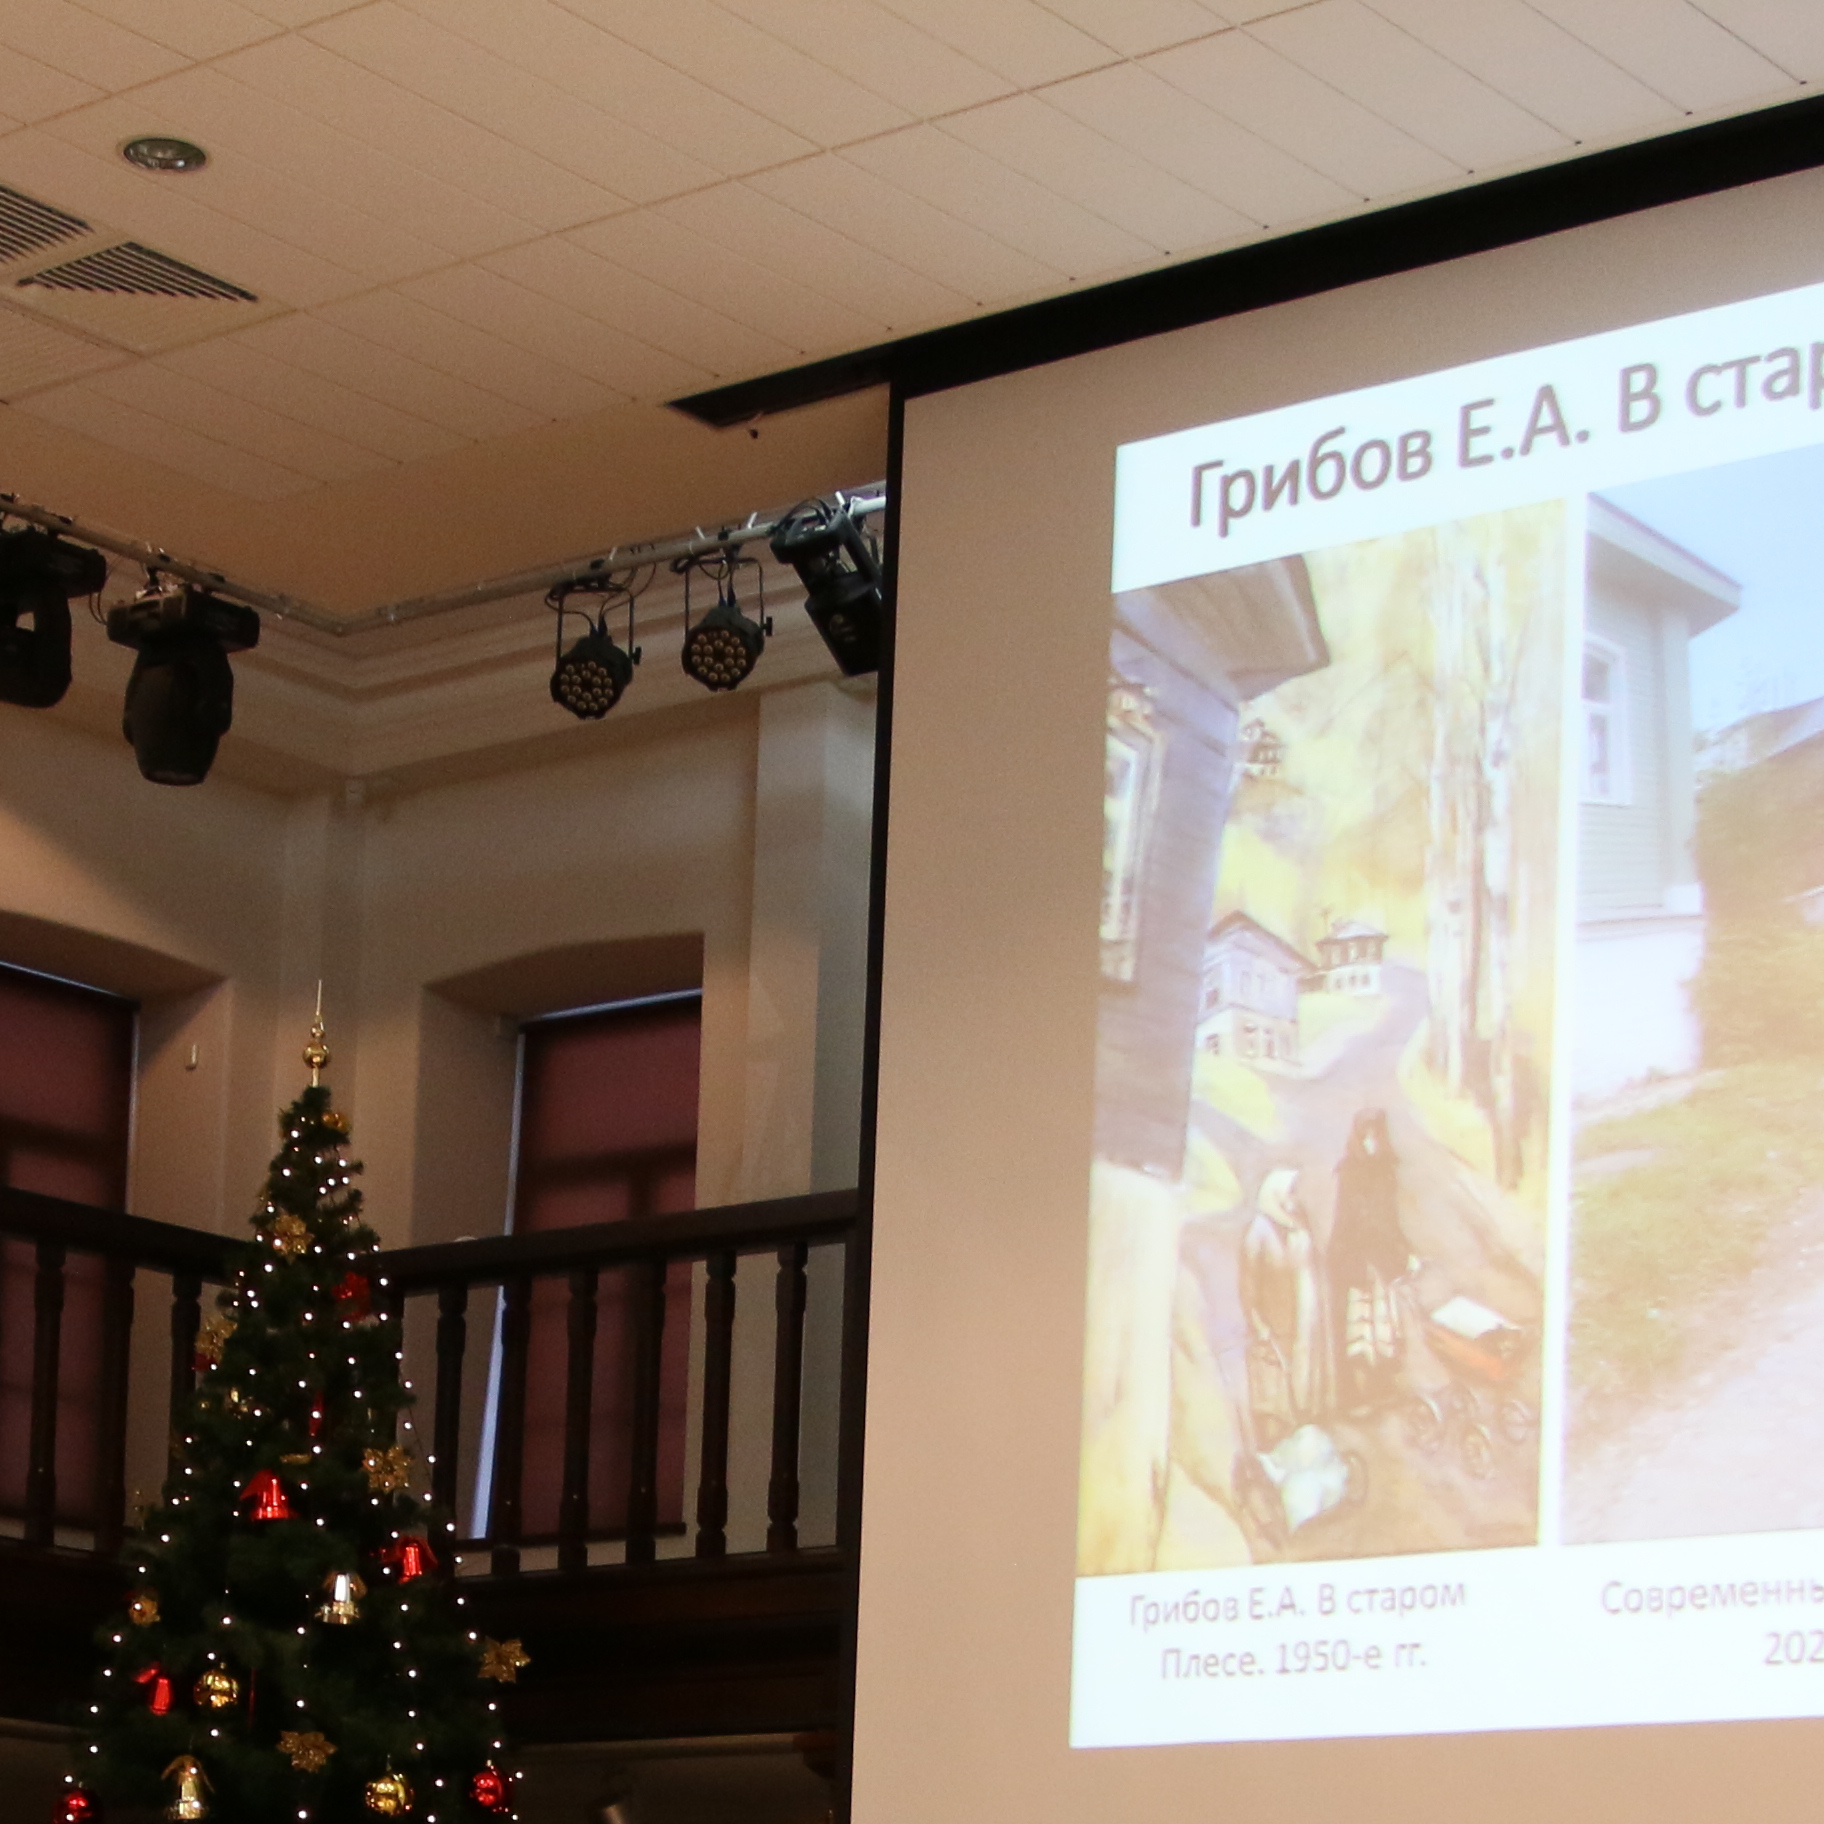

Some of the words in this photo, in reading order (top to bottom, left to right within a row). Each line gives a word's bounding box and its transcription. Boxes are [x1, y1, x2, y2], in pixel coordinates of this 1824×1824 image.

[1190, 426, 1433, 539] Грибов
[1458, 384, 1590, 469] Е.А.
[1619, 362, 1662, 433] В
[1129, 1587, 1240, 1633] Грибов
[1248, 1584, 1307, 1622] Е.А.
[1316, 1583, 1338, 1618] В
[1345, 1580, 1467, 1619] старом
[1160, 1645, 1265, 1681] Плесе.
[1274, 1637, 1384, 1677] 1950-е
[1393, 1640, 1428, 1669] гг.
